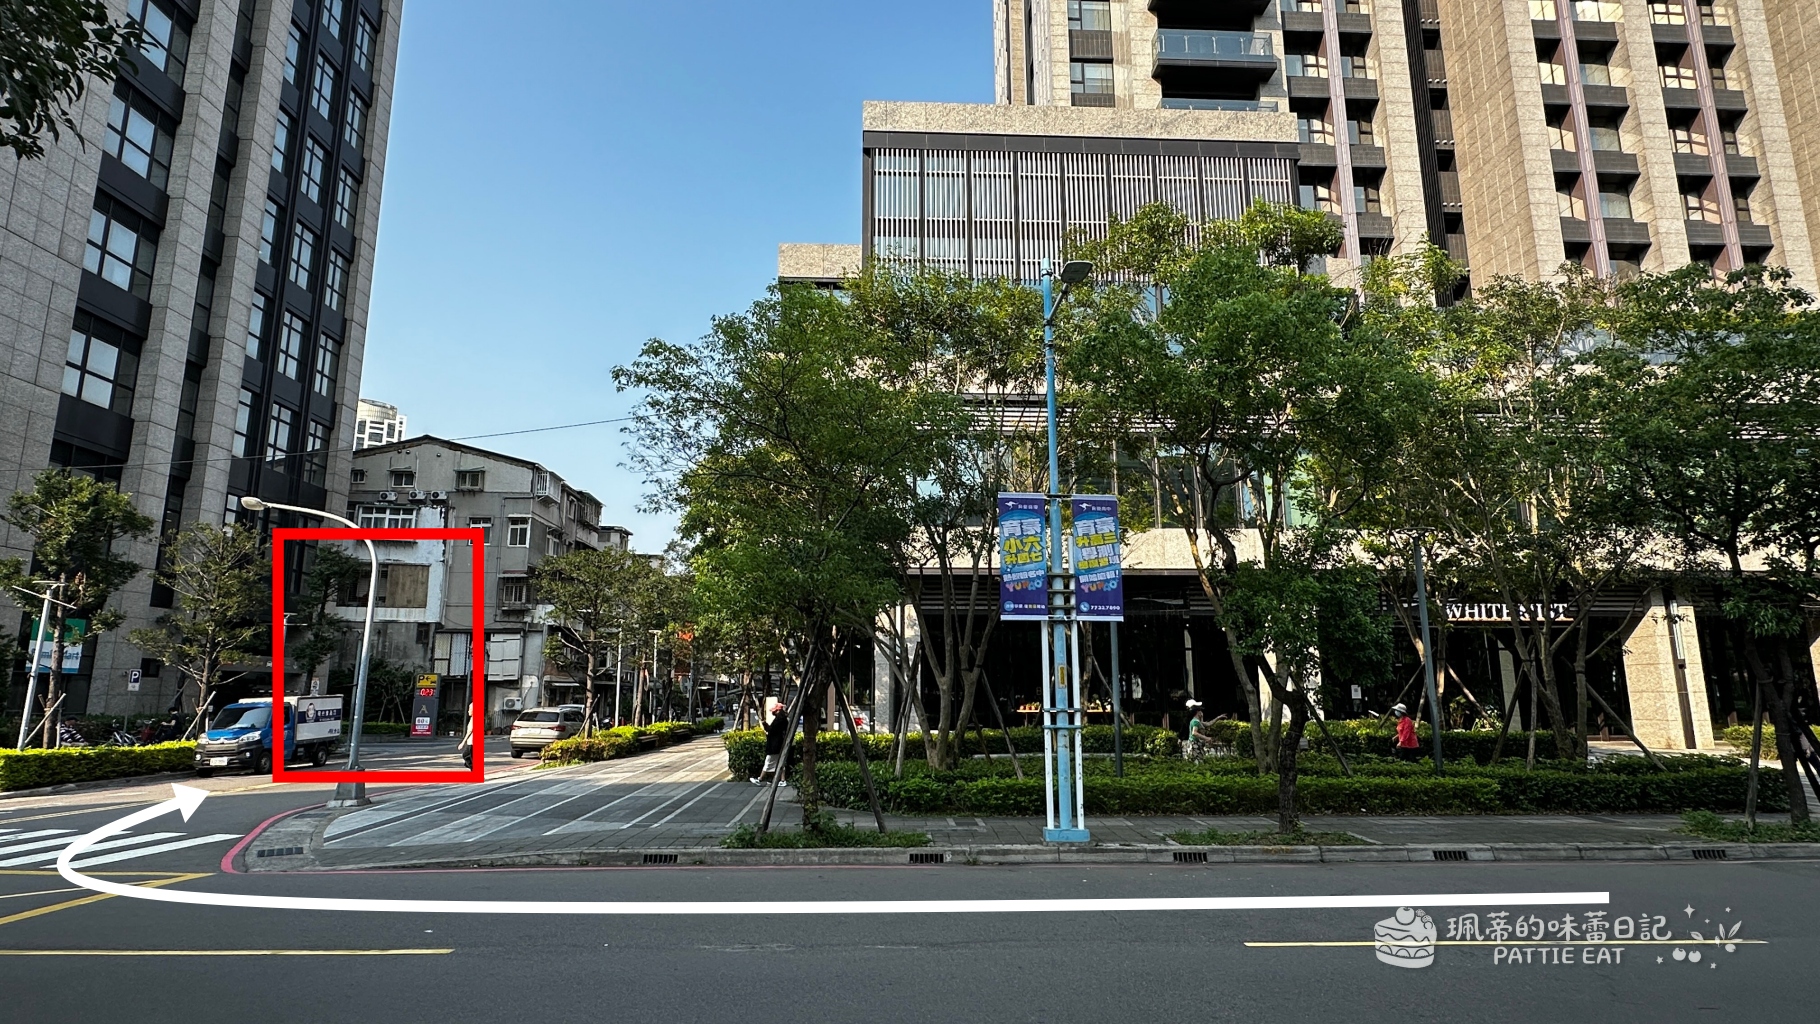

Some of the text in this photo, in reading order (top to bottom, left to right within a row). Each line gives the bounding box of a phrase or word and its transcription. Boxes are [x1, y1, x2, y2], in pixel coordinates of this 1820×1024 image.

[1004, 536, 1042, 553] 小六
[131, 671, 140, 682] P
[418, 674, 425, 684] P
